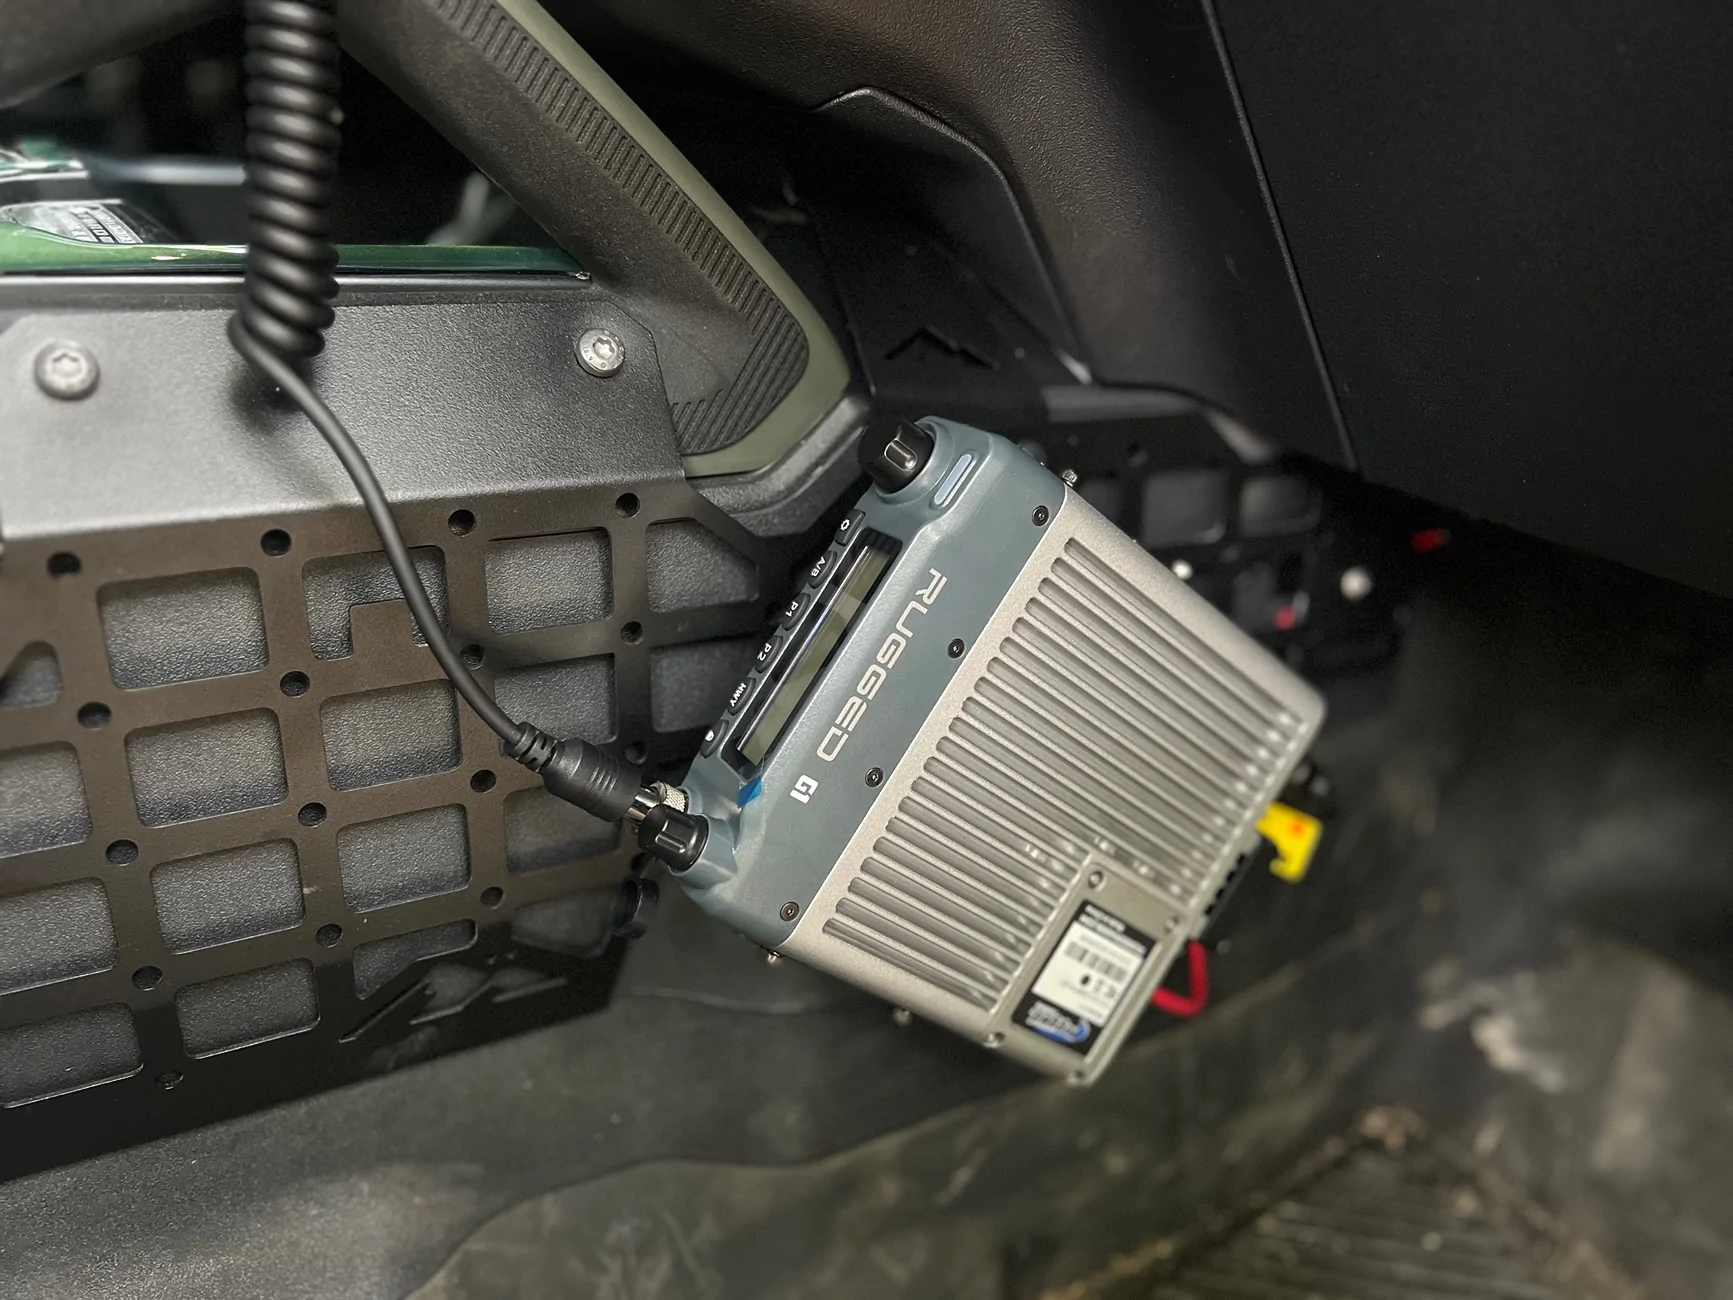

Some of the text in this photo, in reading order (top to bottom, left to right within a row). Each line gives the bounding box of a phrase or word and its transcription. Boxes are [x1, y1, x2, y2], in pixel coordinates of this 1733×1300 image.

[810, 556, 826, 578] A/B
[785, 601, 799, 618] P1
[757, 642, 772, 662] P2
[729, 682, 747, 707] HWY
[789, 568, 948, 804] RUGGED G1
